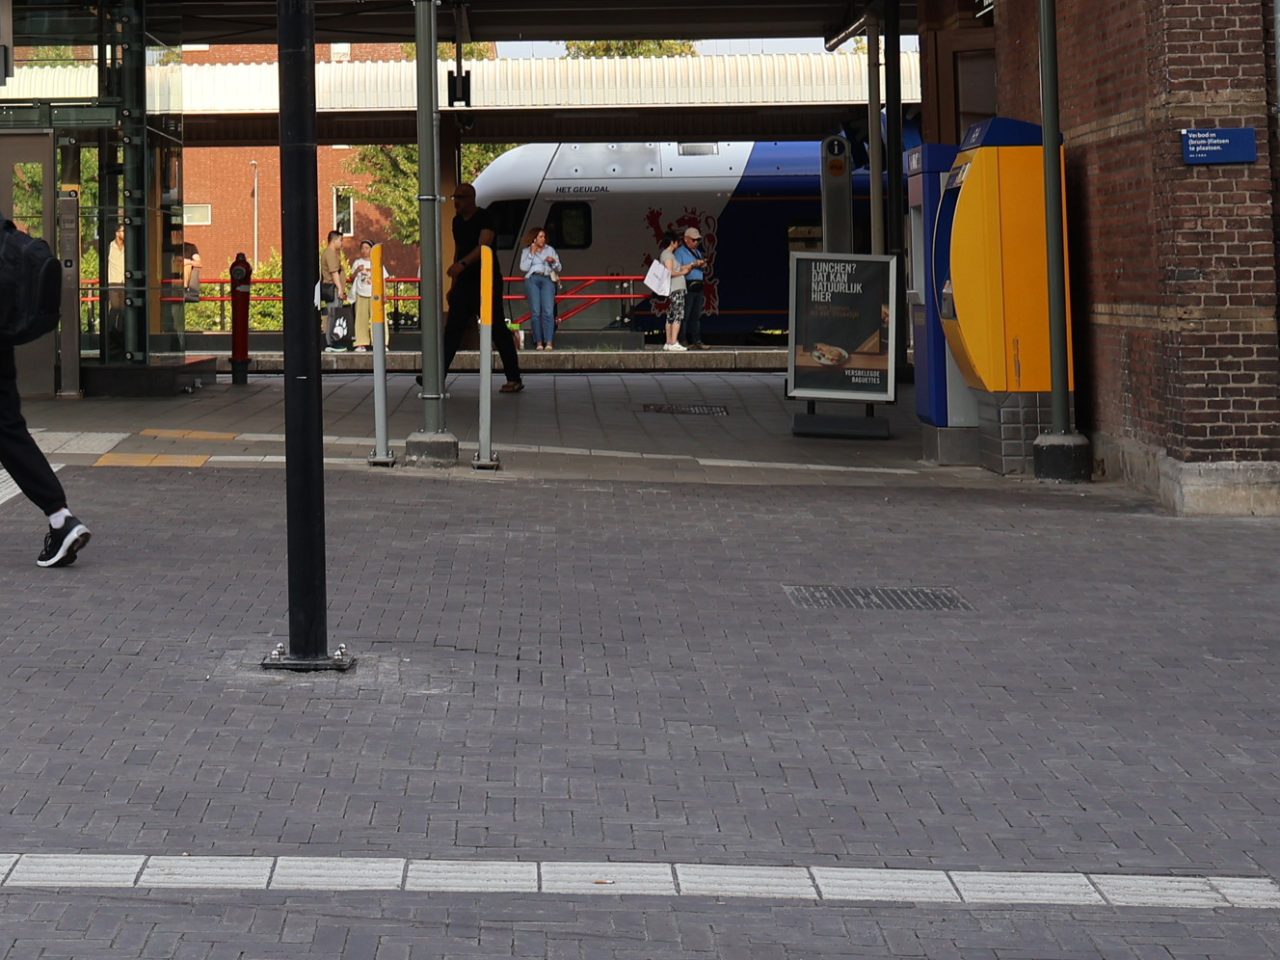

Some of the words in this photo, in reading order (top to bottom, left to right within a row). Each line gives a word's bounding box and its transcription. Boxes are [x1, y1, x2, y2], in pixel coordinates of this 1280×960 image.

[573, 185, 610, 193] GEULDAL
[812, 262, 857, 273] LUNCHEN?
[812, 272, 827, 282] DAT
[830, 272, 848, 283] KAN
[811, 282, 863, 293] NATUURLIJK
[811, 292, 831, 302] HIER
